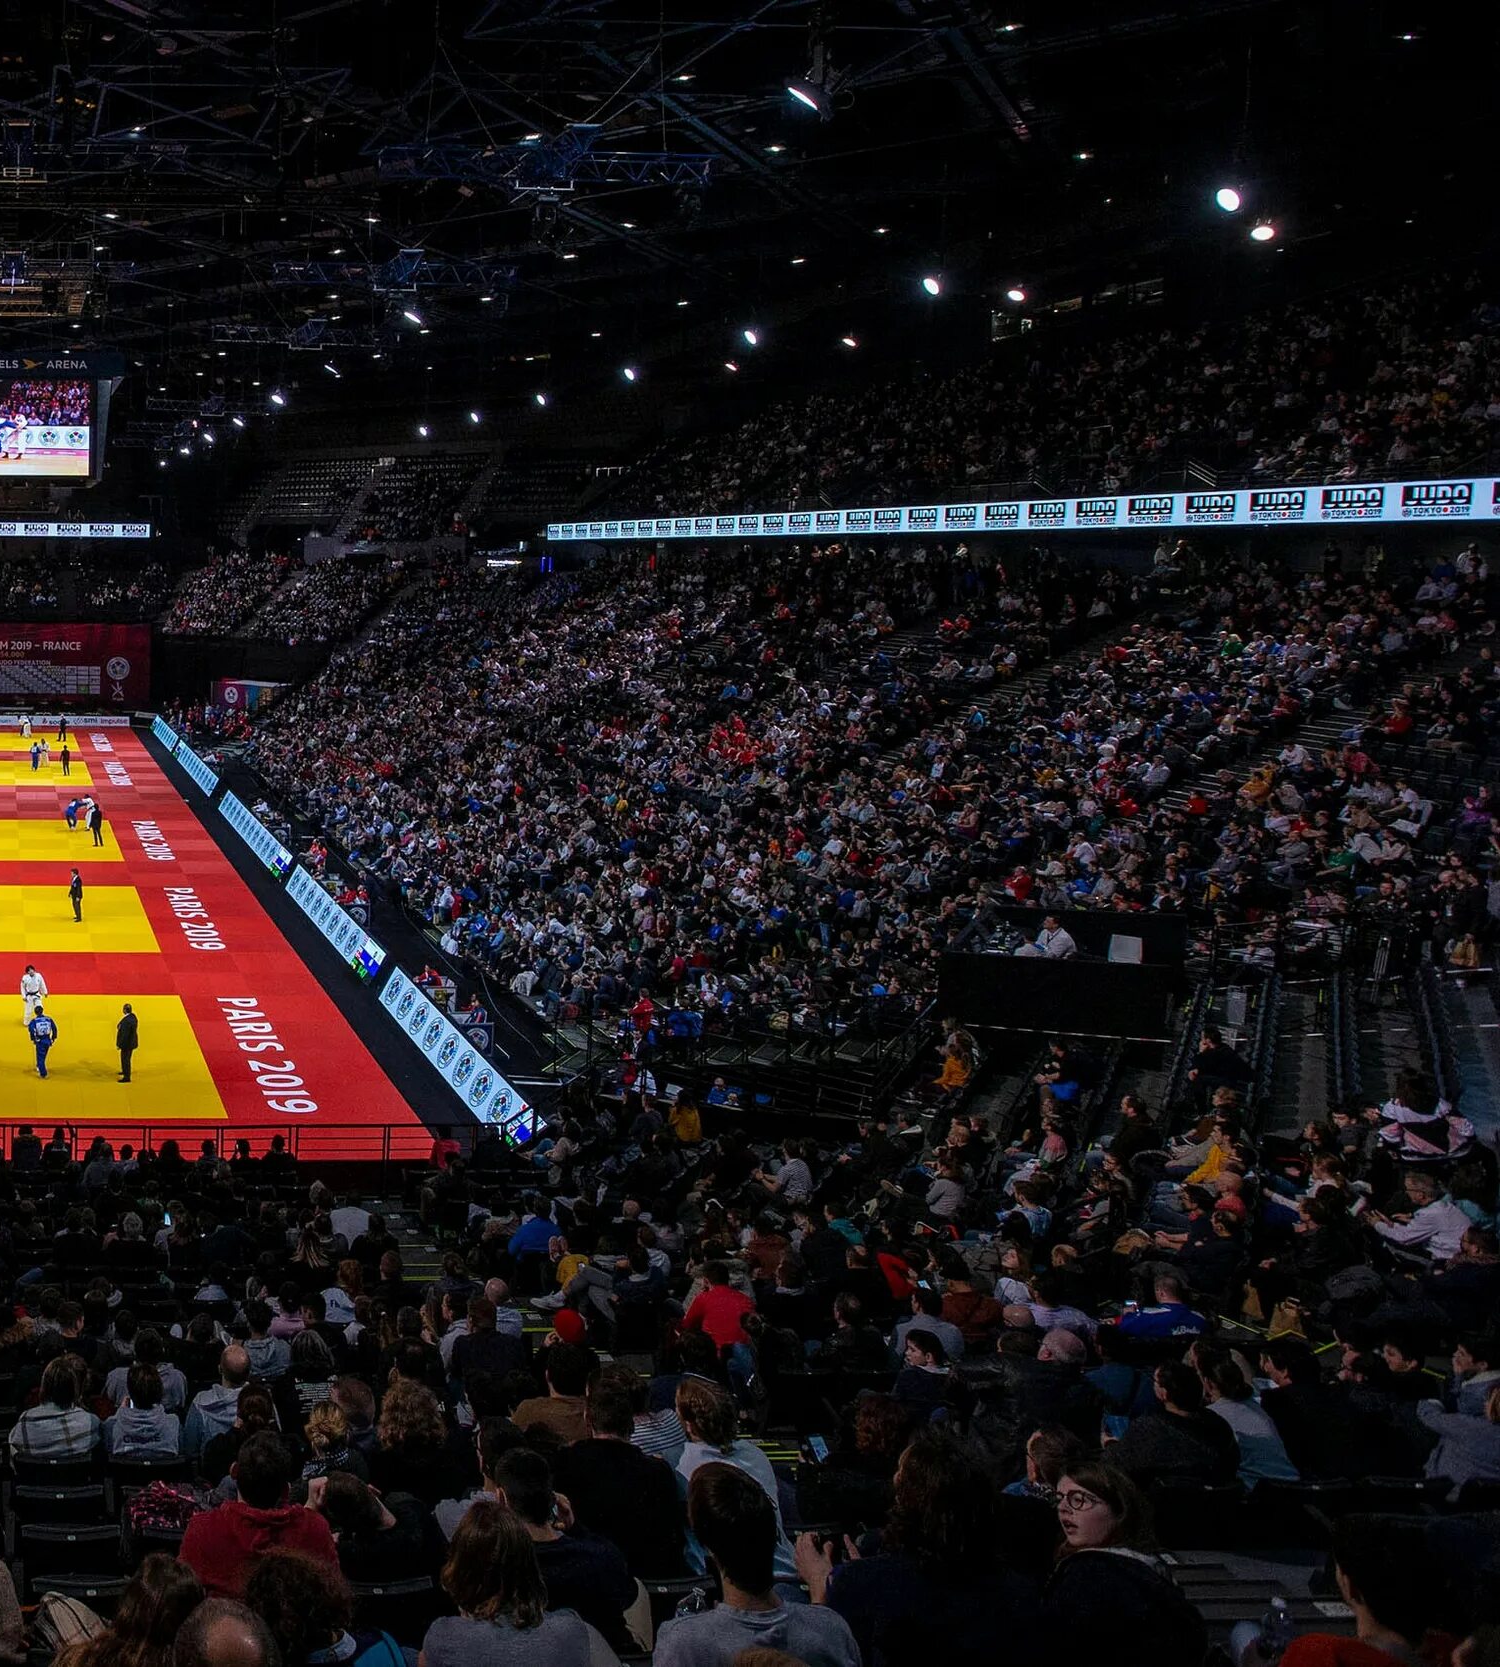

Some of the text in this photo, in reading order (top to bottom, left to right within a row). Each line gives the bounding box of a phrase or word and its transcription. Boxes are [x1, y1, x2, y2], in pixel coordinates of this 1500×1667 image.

[46, 360, 88, 369] ARENA
[1252, 492, 1302, 510] JUDO
[1324, 489, 1381, 508] JUDO
[1405, 484, 1469, 506] JUDO
[1030, 504, 1064, 518] JUDO
[1077, 501, 1114, 517] JUDO
[1129, 499, 1171, 515] JUDO
[1189, 496, 1233, 512] JUDO
[1413, 507, 1441, 515] TOKYO
[986, 506, 1017, 519] JUDO
[11, 641, 32, 650] 2019
[43, 642, 82, 650] FRANCE
[131, 820, 176, 861] PARIS 2019
[163, 887, 226, 951] PARIS 2019
[216, 997, 319, 1114] PARIS 2019
